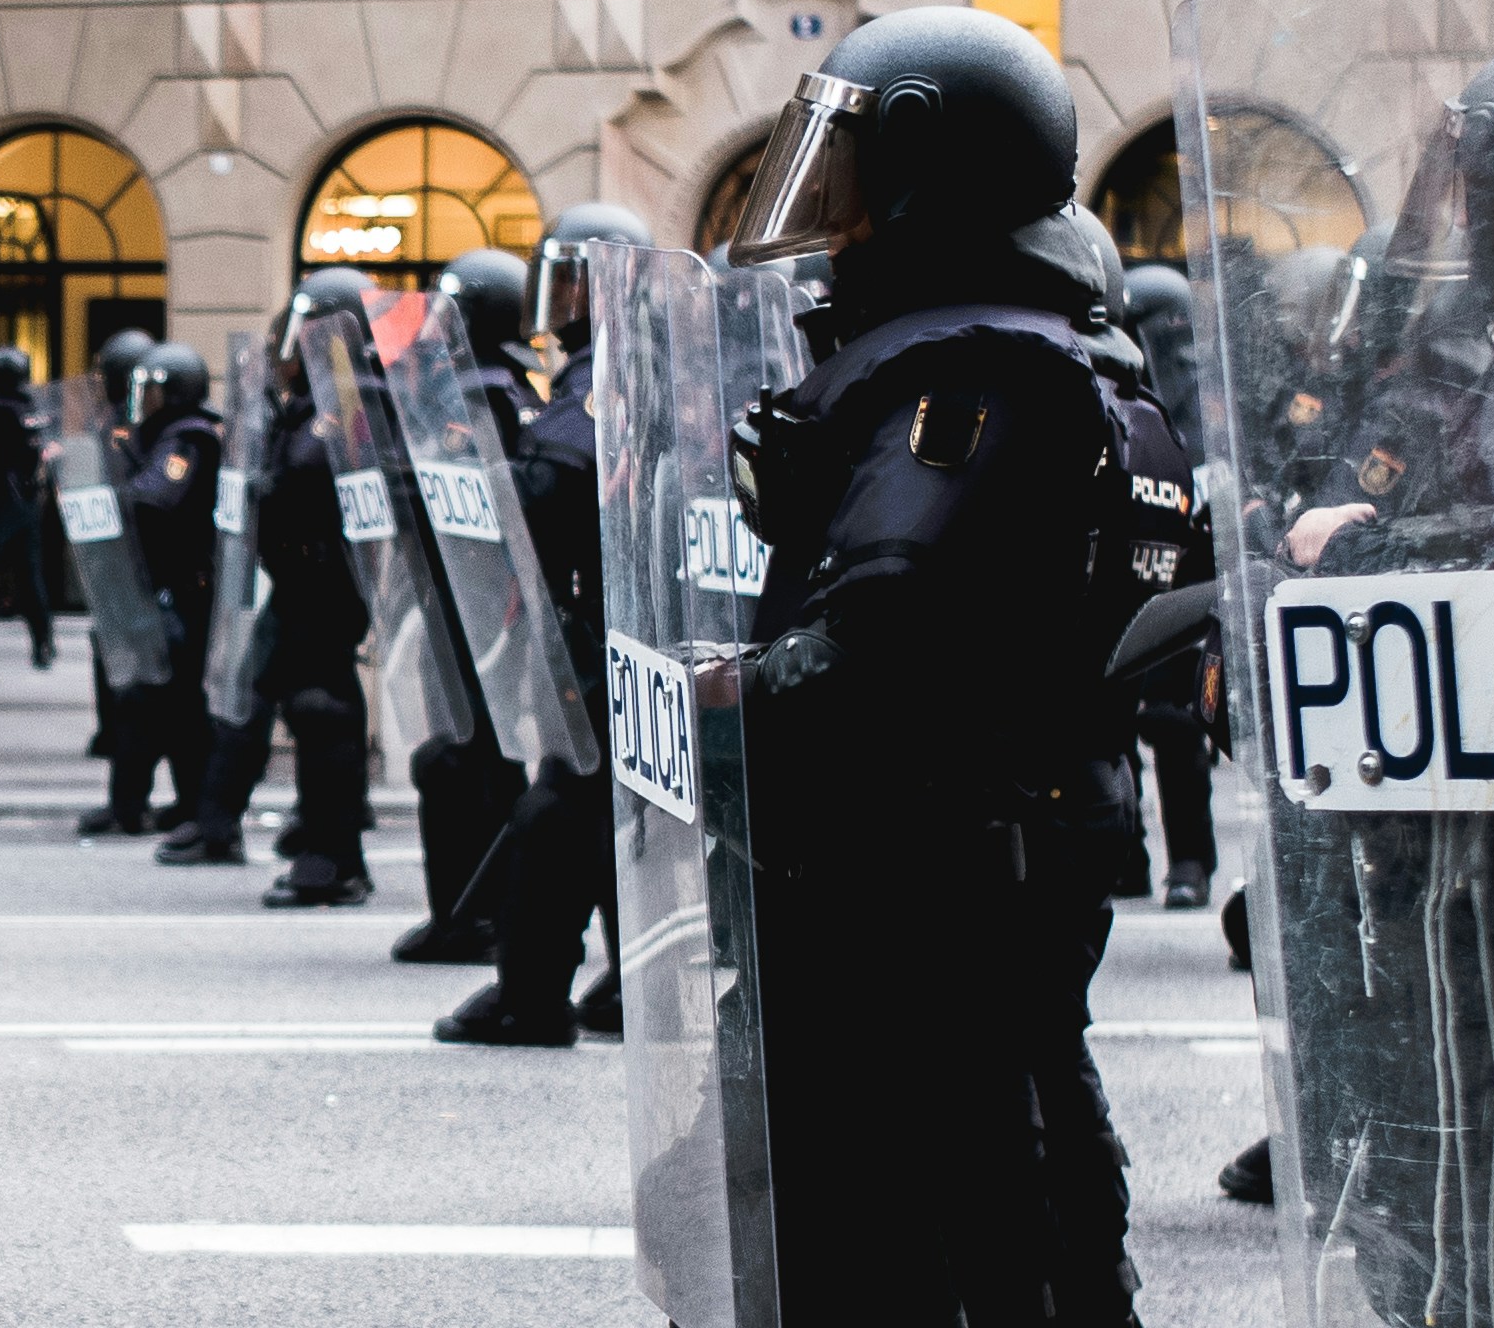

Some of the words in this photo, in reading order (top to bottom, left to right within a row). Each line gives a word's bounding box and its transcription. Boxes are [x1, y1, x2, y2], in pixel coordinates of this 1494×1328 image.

[420, 470, 499, 530] POLICIA
[1132, 475, 1182, 510] POLICIA
[610, 646, 694, 806] POLICIA
